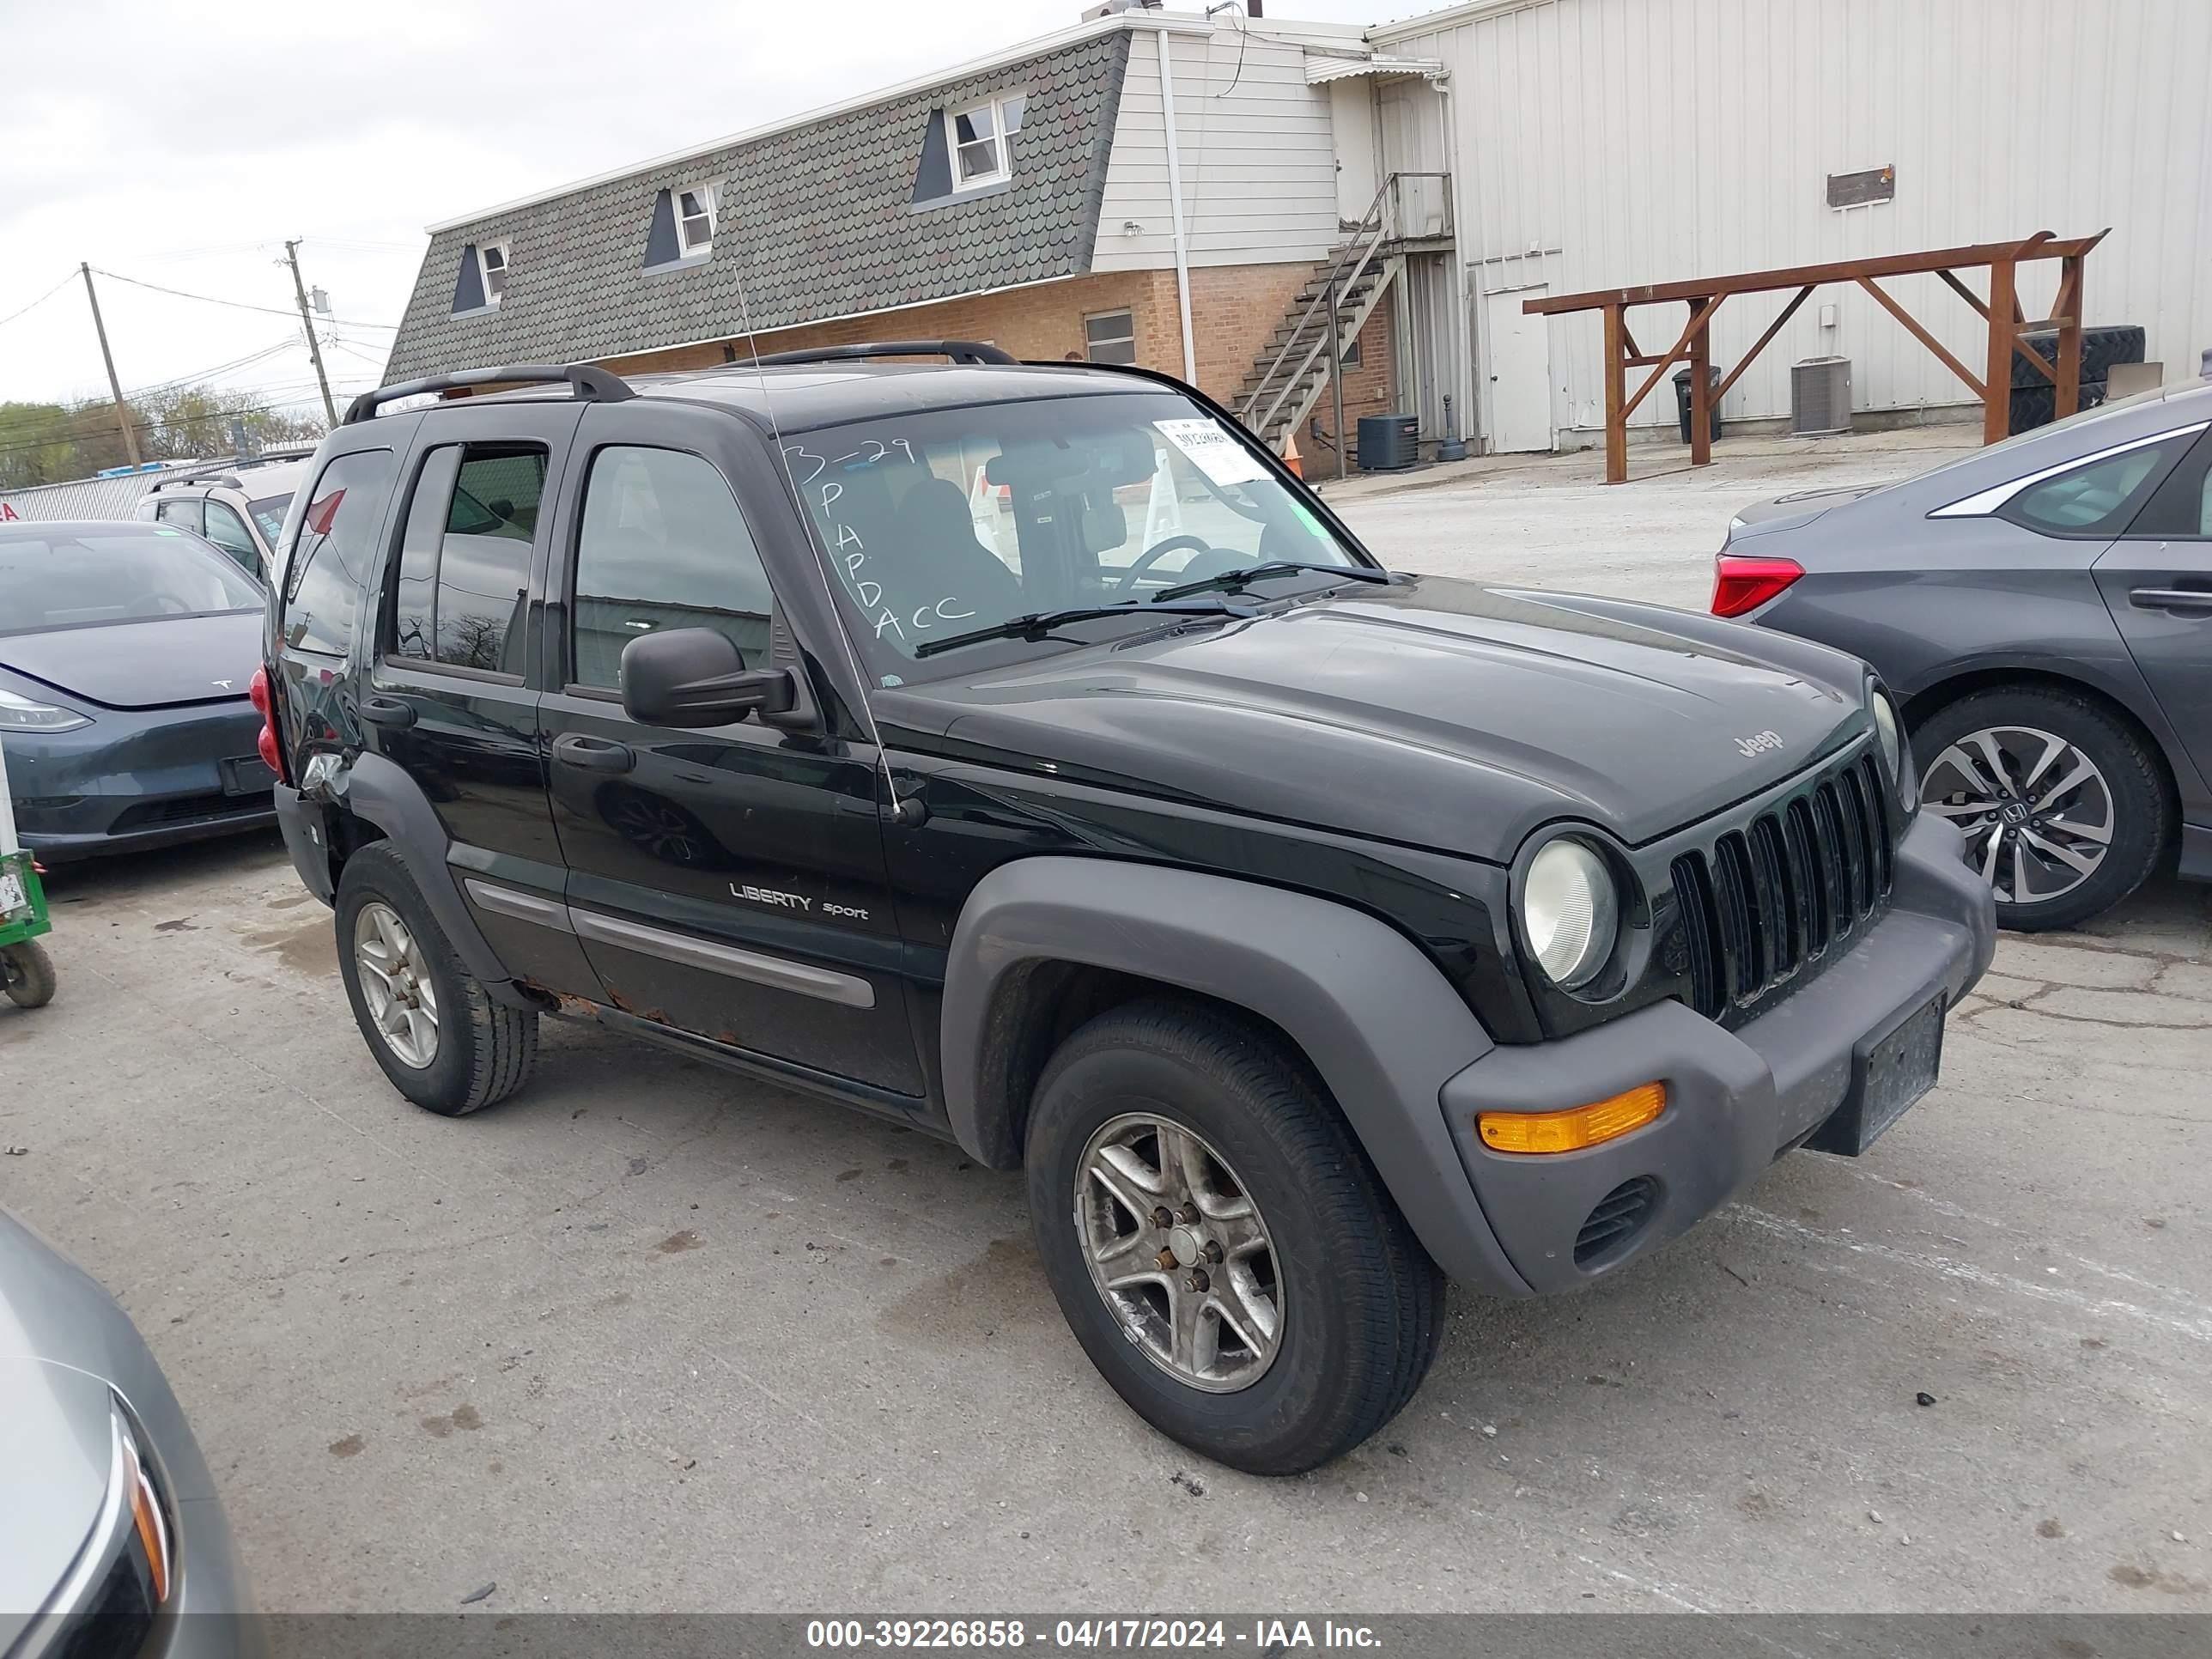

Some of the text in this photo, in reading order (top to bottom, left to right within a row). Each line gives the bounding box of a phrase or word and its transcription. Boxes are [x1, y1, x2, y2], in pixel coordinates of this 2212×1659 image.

[782, 438, 916, 486] 3-29
[1733, 729, 1784, 757] Jeep
[729, 882, 870, 921] LIBERTY sport
